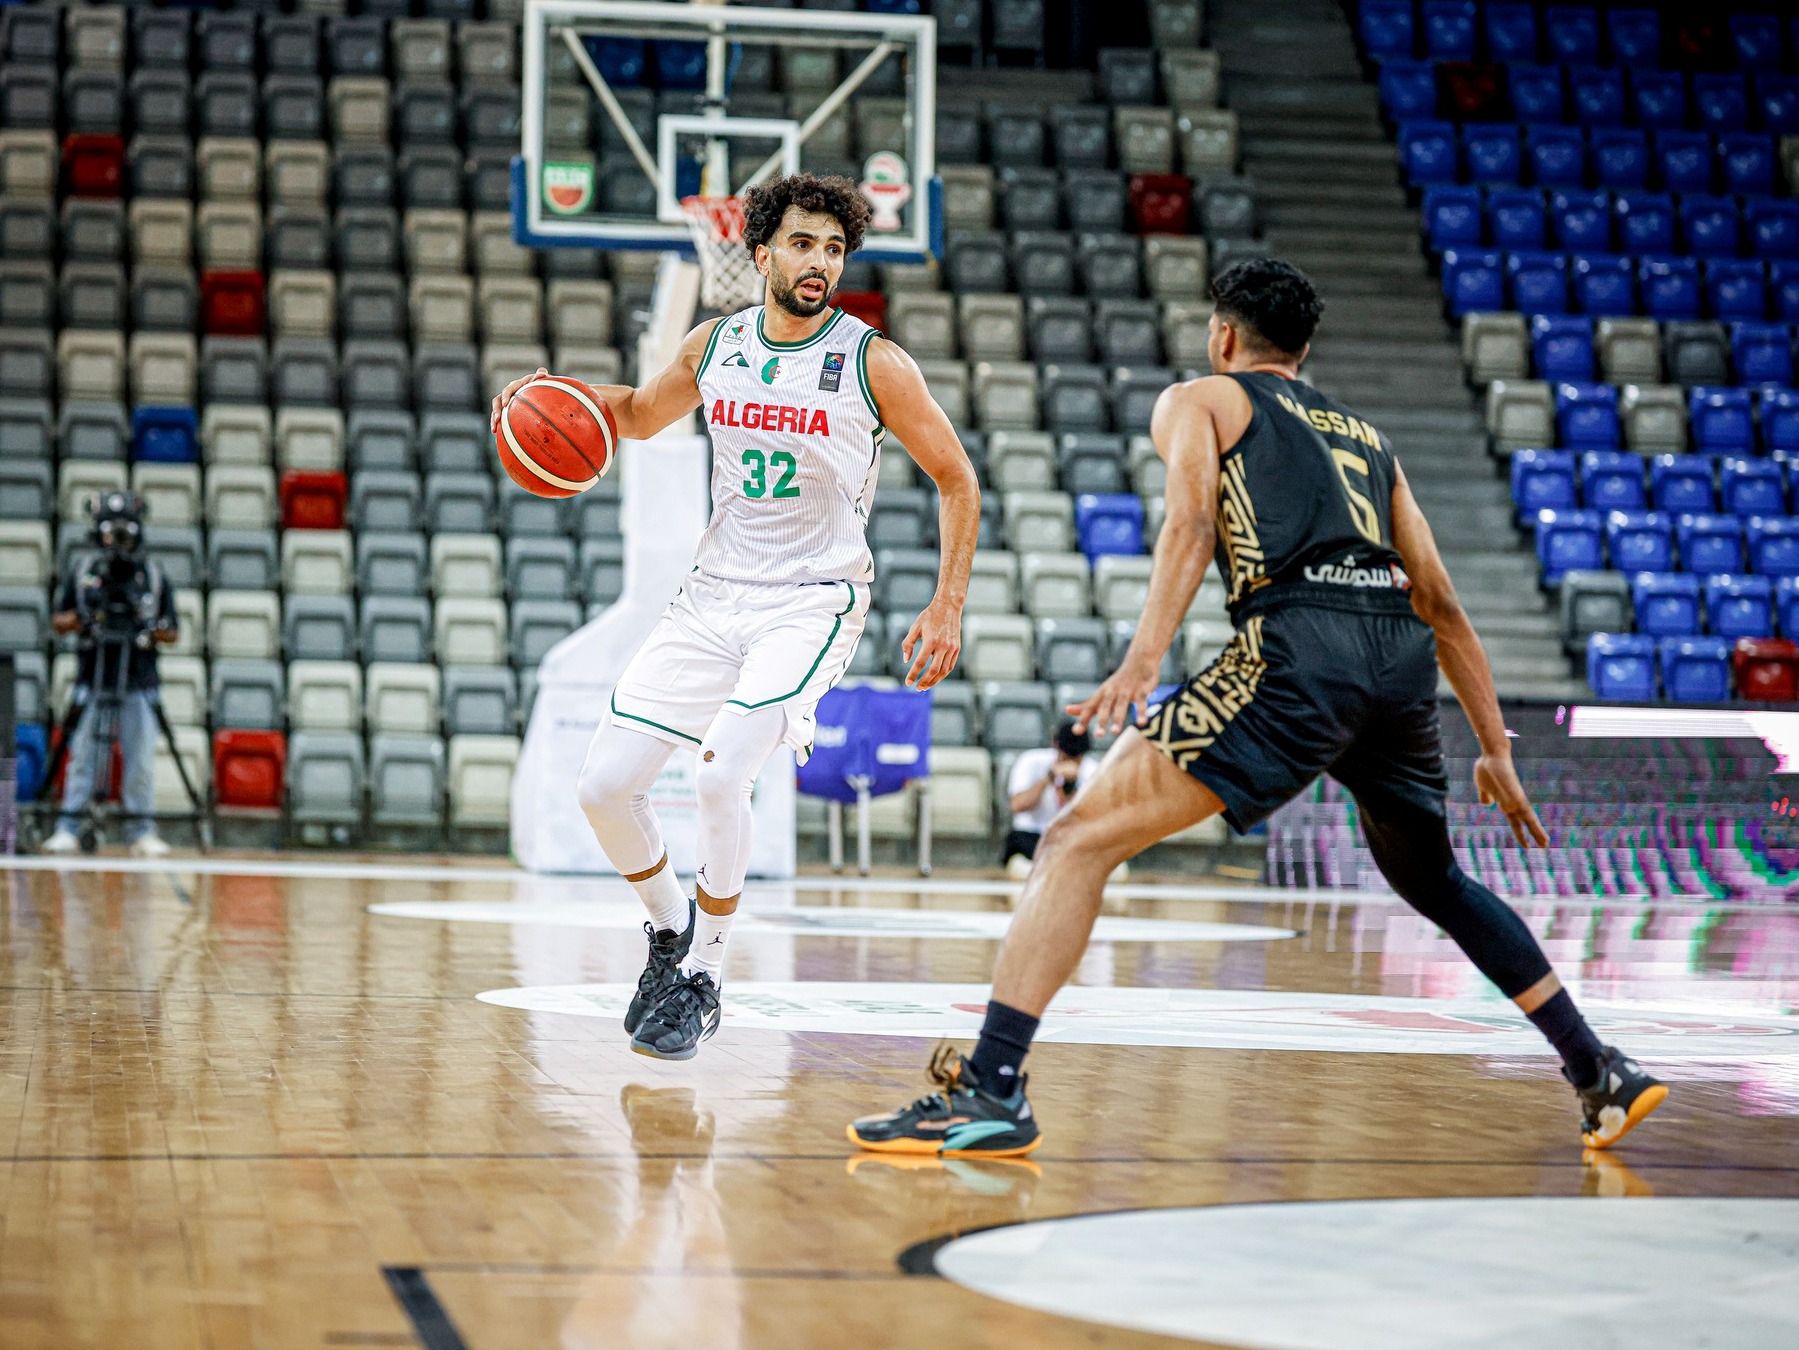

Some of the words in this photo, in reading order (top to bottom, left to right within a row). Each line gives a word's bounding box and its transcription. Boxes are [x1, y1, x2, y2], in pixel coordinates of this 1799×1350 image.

[823, 373, 838, 382] FIBA
[711, 399, 830, 437] ALGERIA
[741, 449, 800, 499] 32
